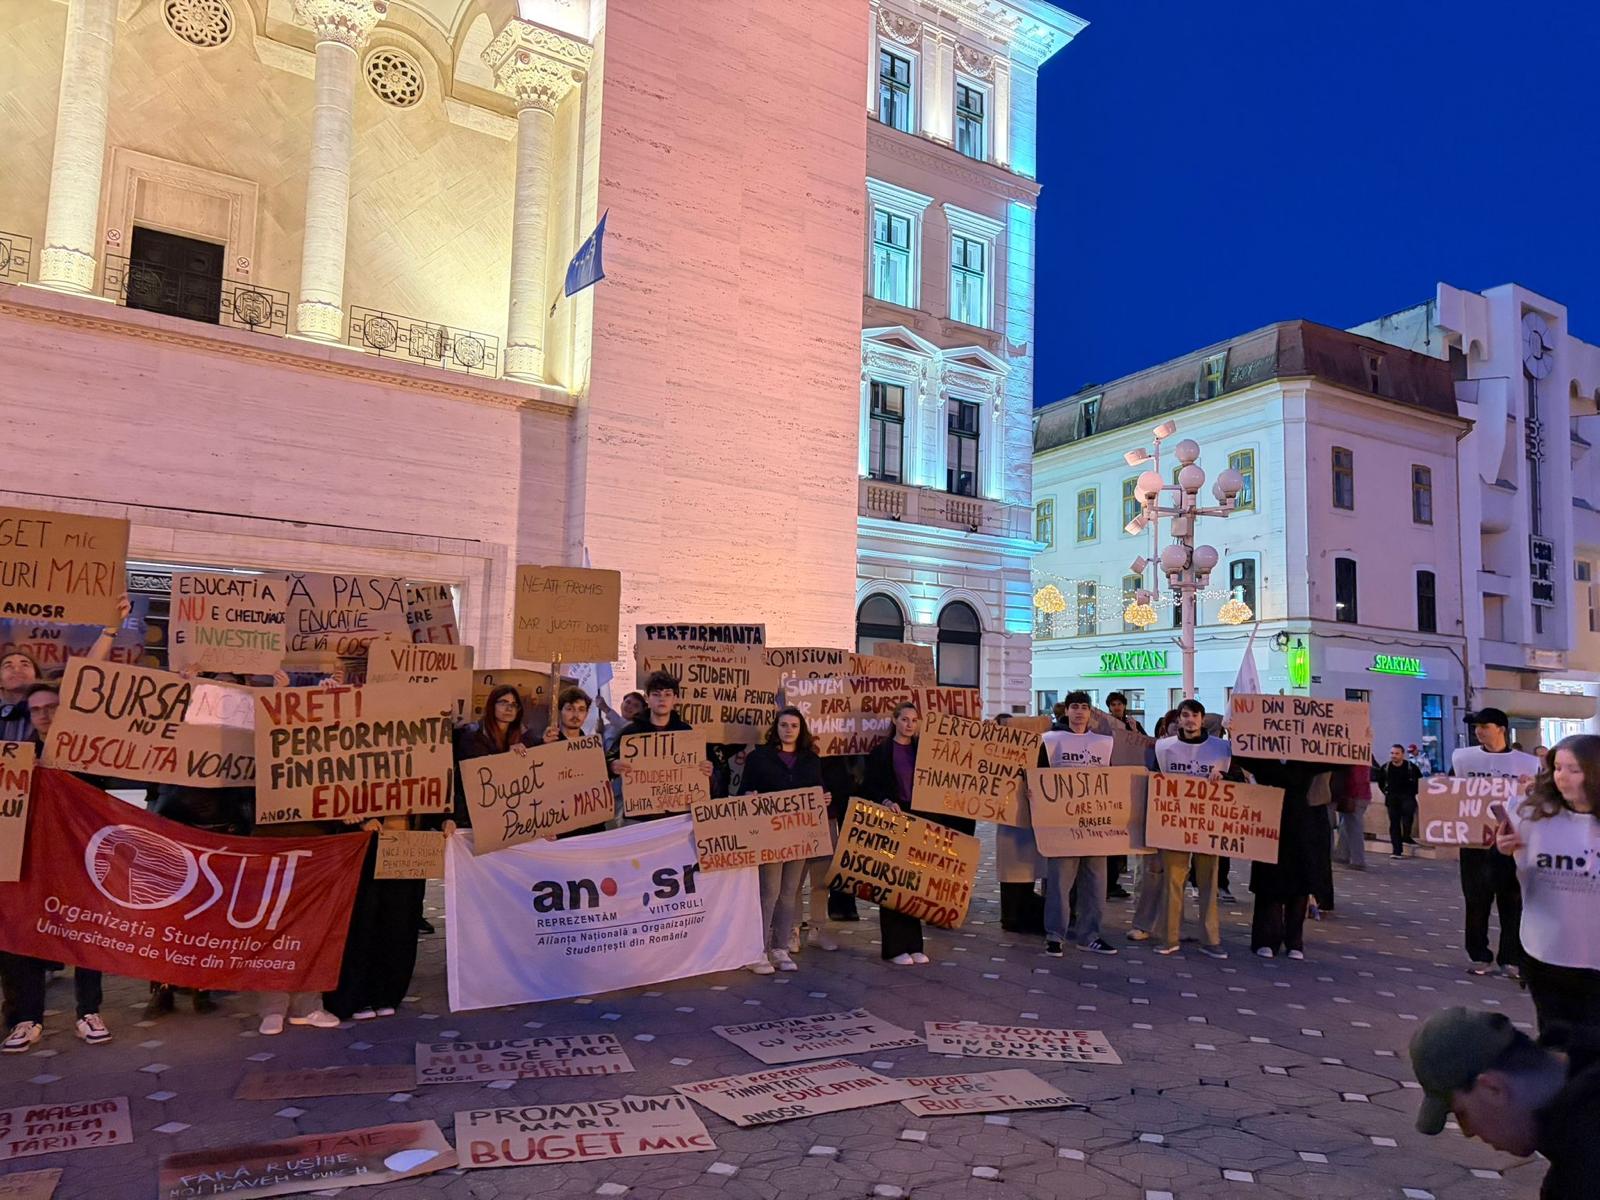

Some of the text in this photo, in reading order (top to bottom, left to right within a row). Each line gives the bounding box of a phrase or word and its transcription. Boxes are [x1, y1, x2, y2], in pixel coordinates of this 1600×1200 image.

[48, 558, 116, 598] MARI
[179, 576, 276, 602] EDUCAȚIA
[332, 576, 405, 613] PASĂ
[3, 602, 65, 618] ANOSR
[177, 596, 219, 622] NU E
[299, 609, 369, 634] EDUCAȚIE
[28, 627, 60, 640] SAU
[176, 631, 185, 644] E
[291, 634, 308, 651] CE
[1100, 650, 1168, 672] SPARTAN
[1375, 654, 1420, 672] SPARTAN
[688, 664, 750, 688] STUDENȚII
[786, 676, 911, 697] SUNTEM VIITORUL
[69, 665, 192, 723] BURSA
[693, 687, 708, 699] DE
[712, 687, 737, 702] VINĂ
[1234, 698, 1254, 713] NU
[1262, 697, 1285, 715] DIN
[1294, 699, 1334, 718] BURSE
[128, 718, 181, 740] NU E
[1264, 718, 1305, 736] FACEȚI
[566, 736, 603, 752] ANOSR
[624, 733, 675, 763] ȘTIȚI
[1236, 733, 1371, 762] STIMAȚI POLITICIENI
[477, 759, 545, 808] Buget
[688, 783, 700, 792] LA
[1153, 773, 1178, 798] ÎN
[260, 808, 302, 822] ANOSR
[502, 780, 614, 841] Prețuri MARI!
[694, 800, 748, 823] EDUCAȚIA
[1065, 800, 1092, 816] CARE
[1190, 802, 1206, 815] NE
[1211, 804, 1263, 823] RUGĂM
[1459, 798, 1482, 817] NU
[1078, 816, 1112, 828] BURSELE
[1161, 814, 1280, 841] PENTRU MINIMUL
[1425, 820, 1469, 844] CER
[697, 834, 748, 857] STATUL
[1184, 831, 1246, 854] DE TRAI
[840, 849, 923, 892] DISCURSURI
[44, 896, 156, 939] Organizația
[272, 934, 301, 951] din
[36, 917, 225, 969] Universitatea de Vest din
[538, 931, 577, 946] Alianța
[580, 927, 628, 942] Națională
[565, 930, 688, 957] Studențești din România
[810, 1014, 837, 1024] NU
[758, 1024, 877, 1048] CU BUGET
[935, 1023, 1089, 1039] ECONOMIE
[869, 1038, 924, 1049] ANOSR
[943, 1038, 1108, 1055] DIN BURSELE
[961, 1046, 1095, 1061] NOASTRE
[430, 1045, 624, 1066] NU SE FACE
[422, 1058, 573, 1076] CU BUGET
[470, 1094, 686, 1126] PROMISIUNI
[743, 1104, 814, 1125] ANOSR
[470, 1131, 711, 1164] BUGET MIC
